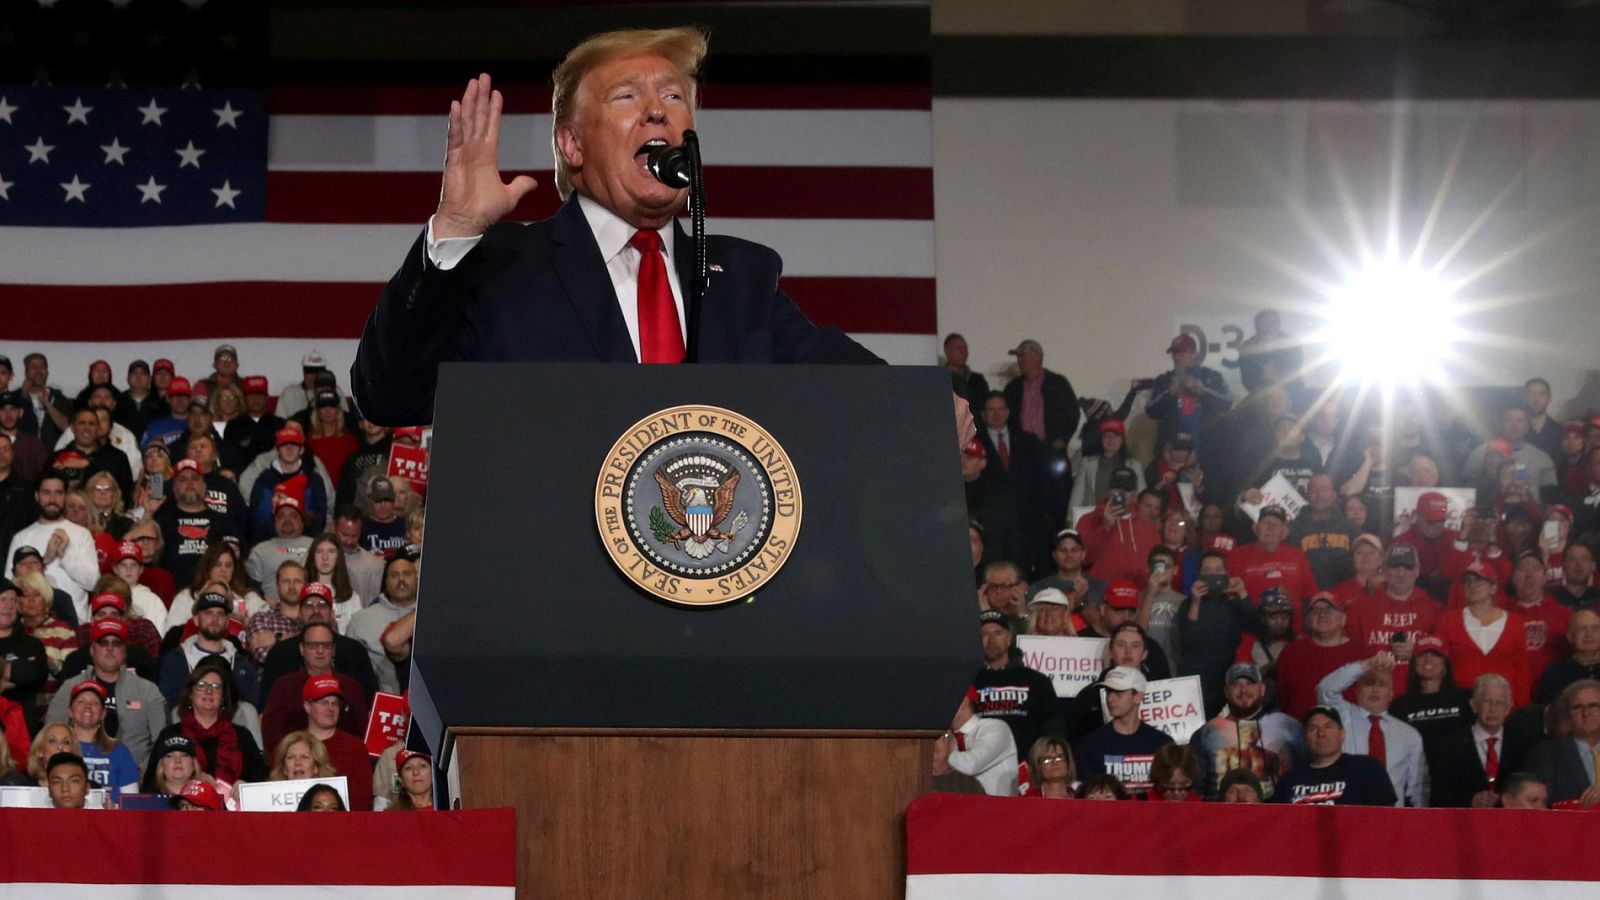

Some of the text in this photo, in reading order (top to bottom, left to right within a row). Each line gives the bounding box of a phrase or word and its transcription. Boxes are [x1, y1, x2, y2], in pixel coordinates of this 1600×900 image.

[395, 457, 428, 472] TRU
[602, 412, 795, 597] SEAL OF THE PRESIDENT OF THE UNITED STATES
[1383, 613, 1417, 626] KEEP
[1023, 651, 1104, 673] Women
[1143, 690, 1172, 705] EEP
[1140, 703, 1198, 722] ERICA
[1292, 781, 1346, 795] Trump
[271, 792, 305, 806] KEE
